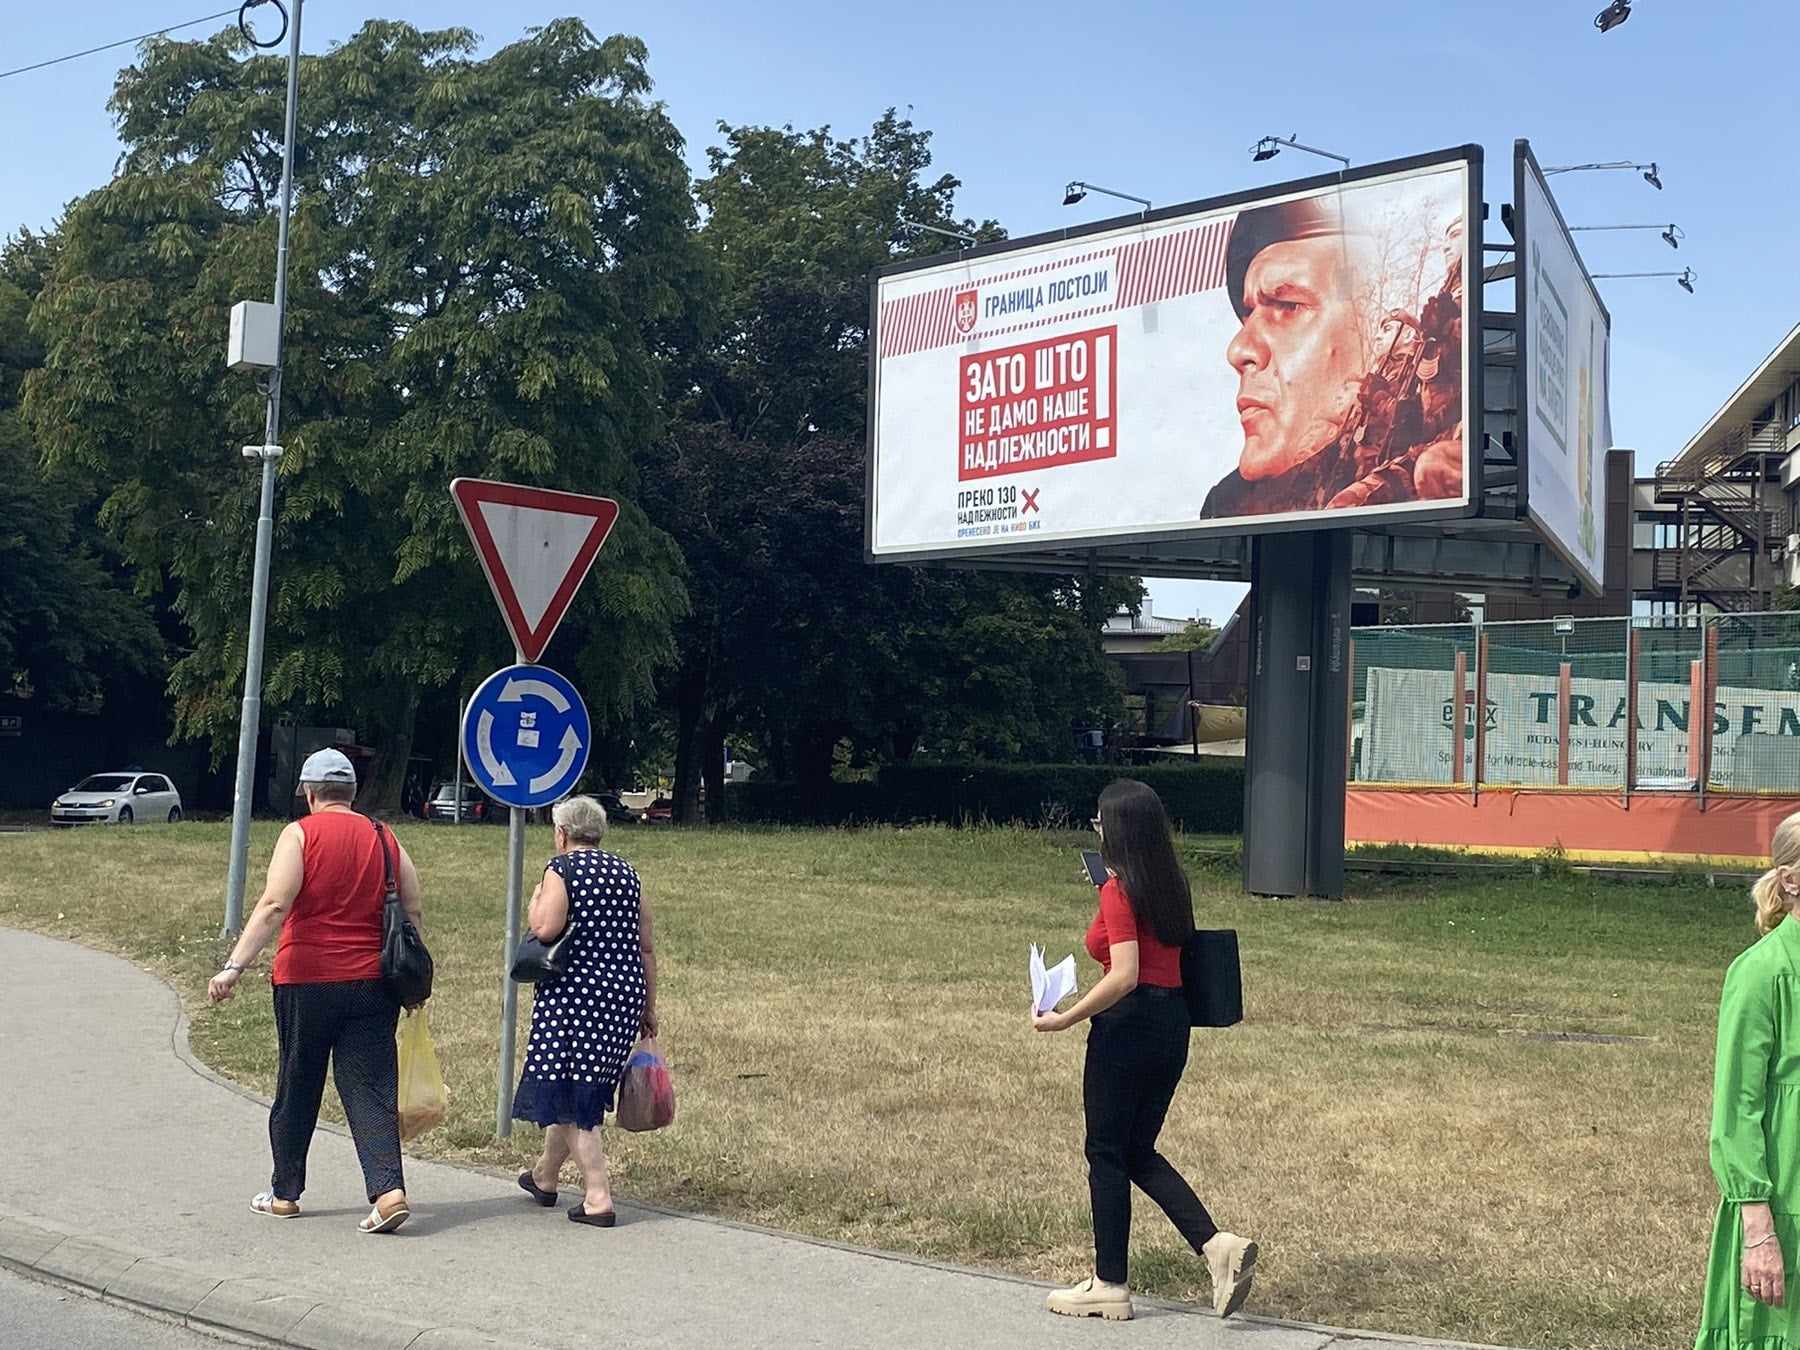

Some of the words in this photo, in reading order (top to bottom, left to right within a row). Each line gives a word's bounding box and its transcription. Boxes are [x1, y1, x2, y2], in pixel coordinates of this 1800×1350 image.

[985, 286, 1044, 318] ГРАНИЦА
[1048, 270, 1108, 305] ПОСТОЈИ
[966, 353, 1026, 403] ЗАТО
[1035, 340, 1088, 390] ШТО
[965, 408, 985, 437] НЕ
[989, 398, 1038, 437] ДАМО
[1043, 387, 1089, 423] НАШЕ
[964, 422, 1090, 471] НАДЛЕЖНОСТИ
[958, 488, 994, 509] ПРЕКО
[998, 485, 1017, 505] 130
[958, 506, 1018, 525] НАДЛЕЖНОСТИ
[1443, 704, 1497, 724] enx
